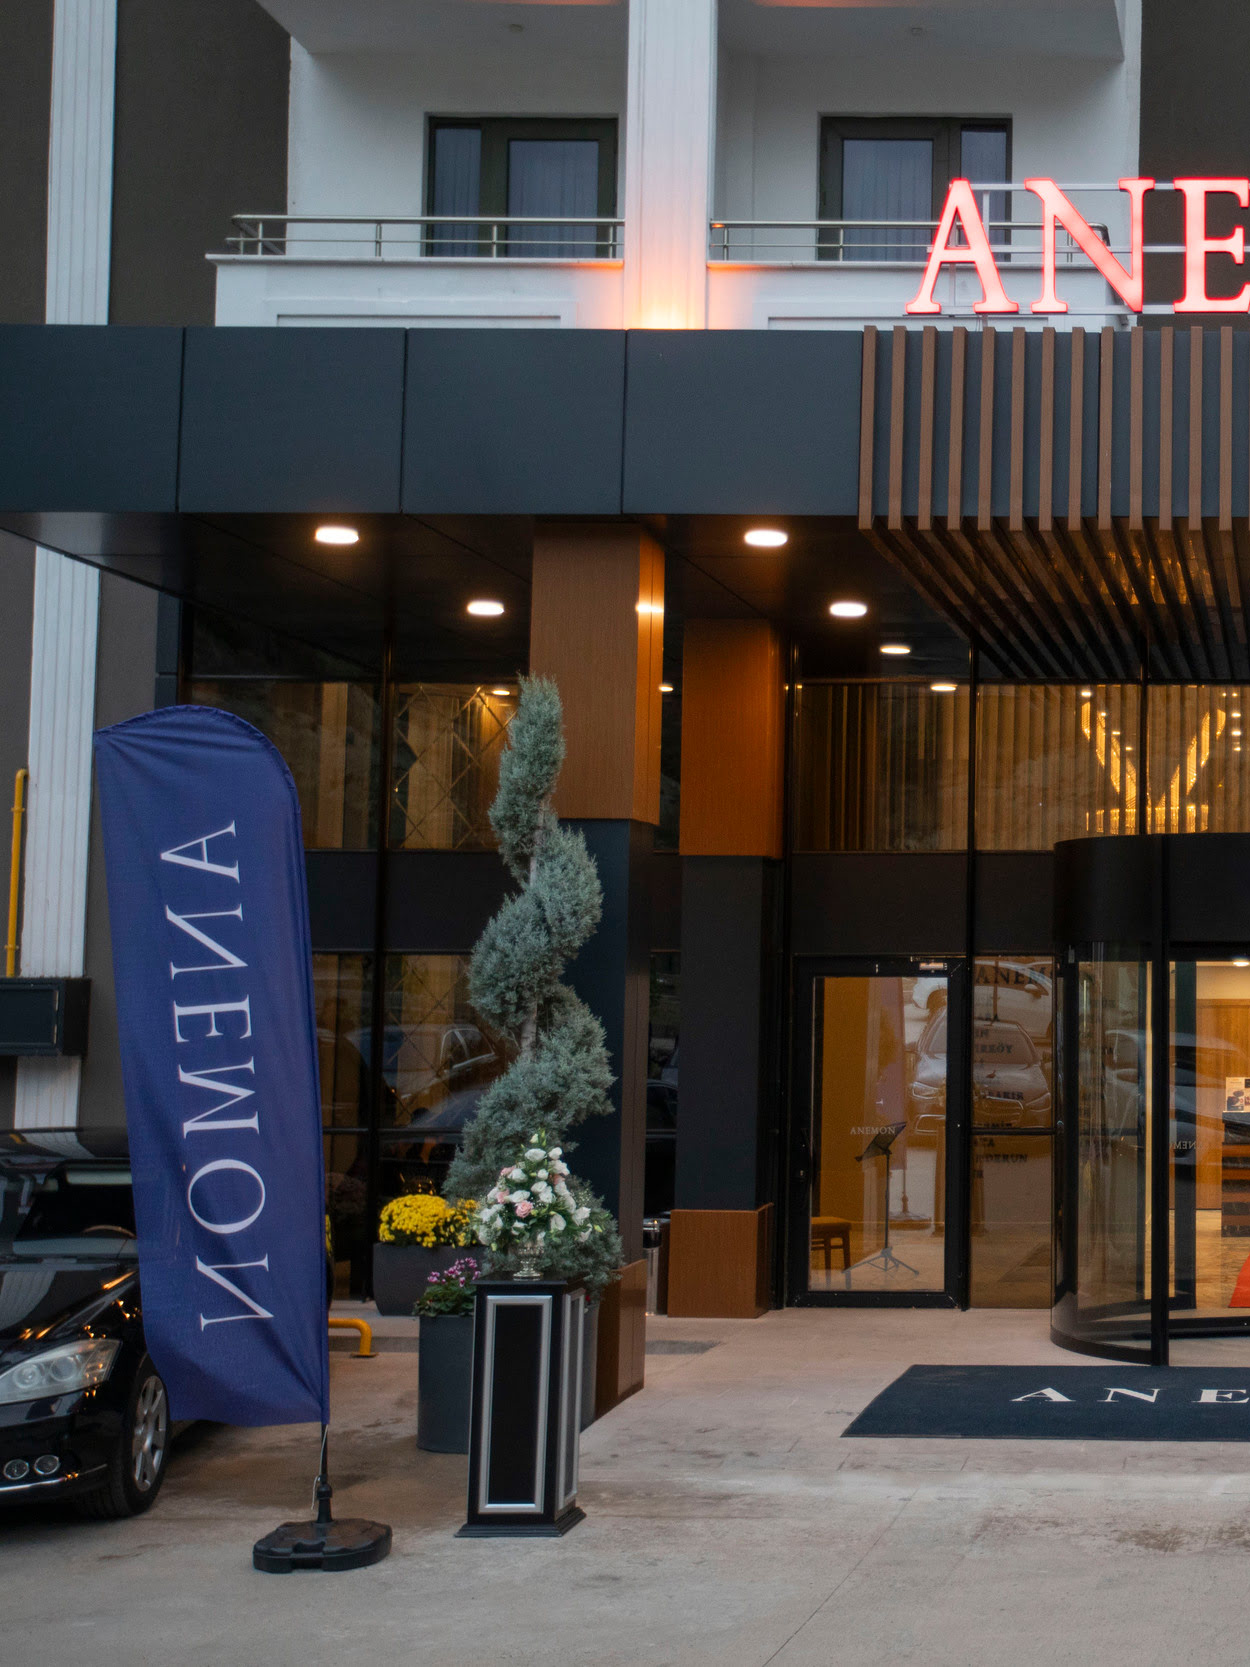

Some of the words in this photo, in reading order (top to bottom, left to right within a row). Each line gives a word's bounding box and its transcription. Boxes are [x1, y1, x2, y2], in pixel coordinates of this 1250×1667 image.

[976, 966, 1053, 984] ANEM
[160, 820, 275, 1332] ANEMON
[850, 1126, 896, 1135] ANEMON
